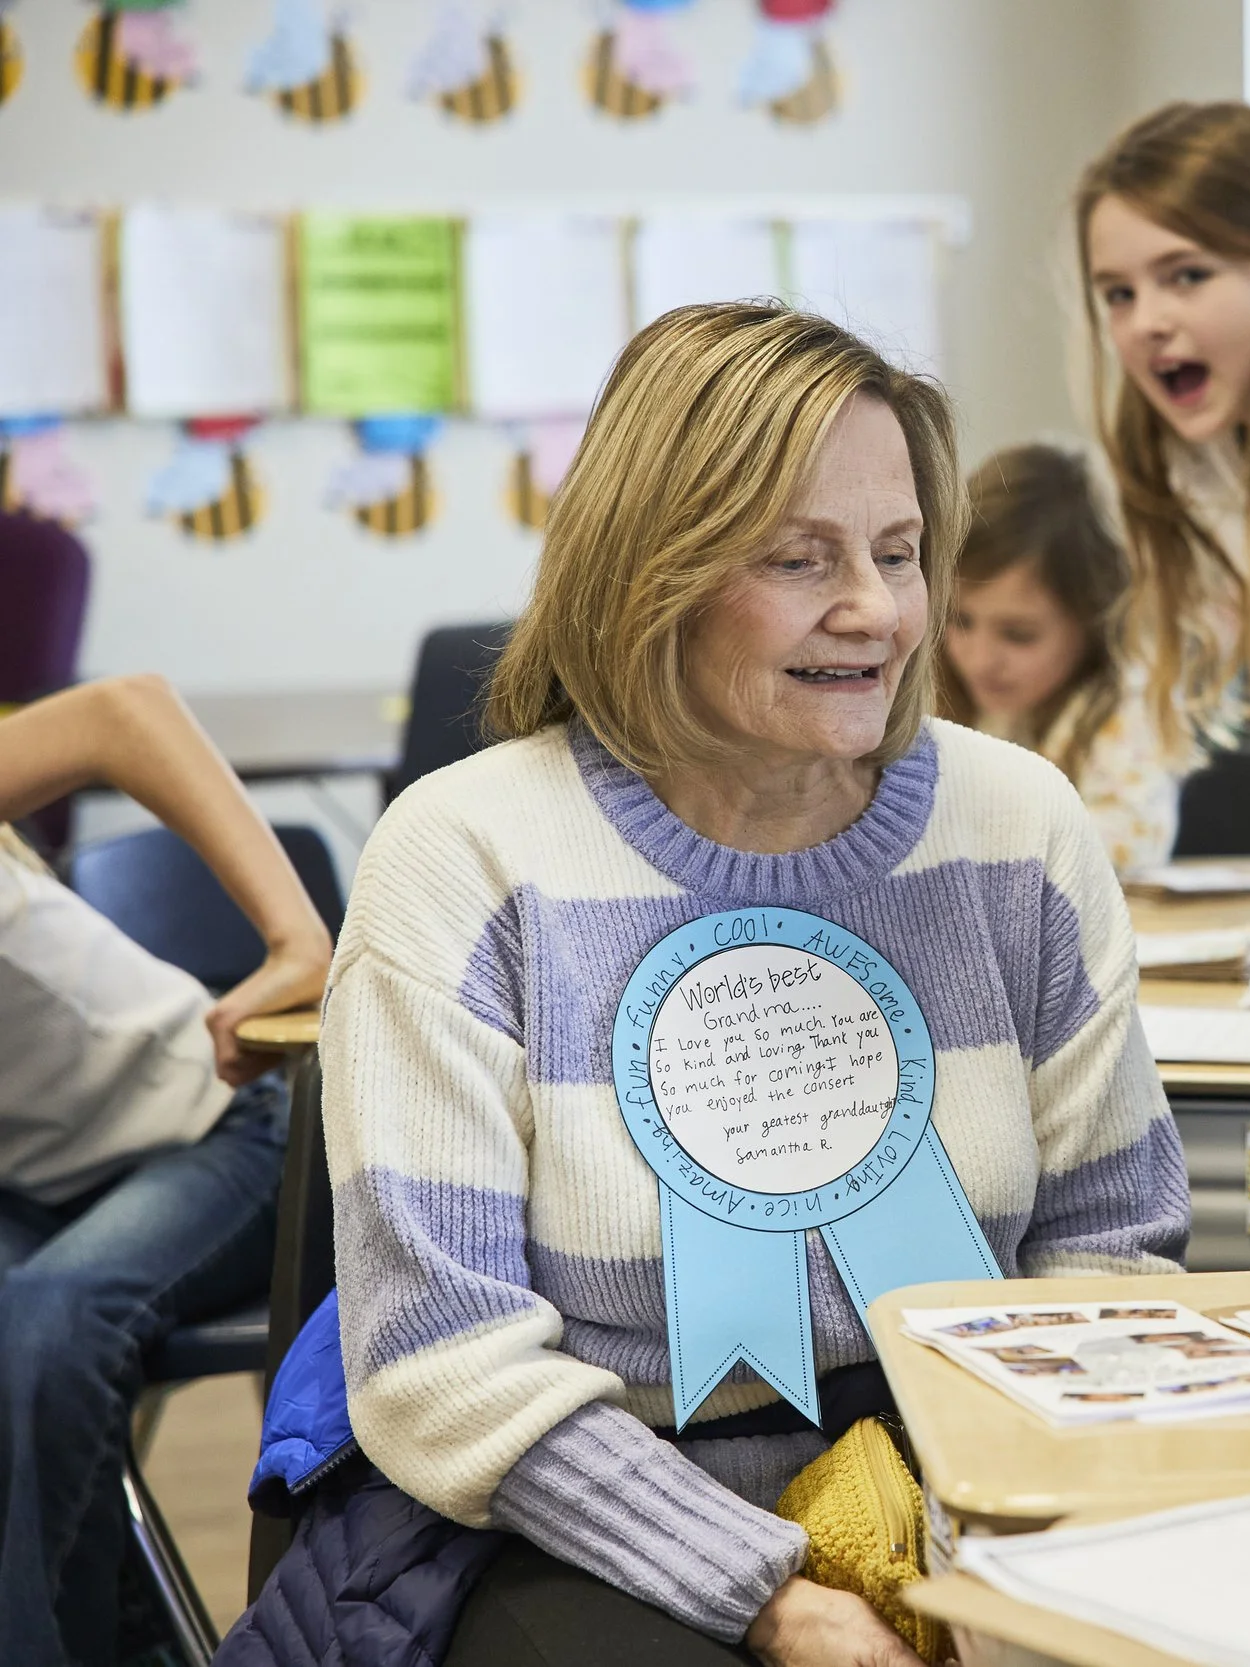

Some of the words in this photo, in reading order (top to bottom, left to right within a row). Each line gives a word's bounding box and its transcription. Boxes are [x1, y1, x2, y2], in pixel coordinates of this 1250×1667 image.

[679, 973, 763, 1012] World's
[767, 958, 822, 993] best
[655, 1037, 668, 1052] I
[723, 1033, 745, 1051] you
[780, 1016, 826, 1036] much.
[831, 1013, 853, 1028] You
[859, 1009, 880, 1022] are
[725, 1048, 752, 1064] and
[809, 1030, 850, 1049] Thank
[856, 1027, 881, 1050] you
[625, 1059, 654, 1110] fun
[685, 1073, 726, 1094] much
[733, 1069, 758, 1087] for
[849, 1050, 884, 1069] hope
[665, 1103, 692, 1121] you
[706, 1086, 757, 1112] enjoyed
[767, 1084, 795, 1101] the
[803, 1074, 856, 1095] consert
[722, 1122, 750, 1141] your
[735, 1141, 812, 1165] Samantha
[820, 1138, 834, 1152] R.
